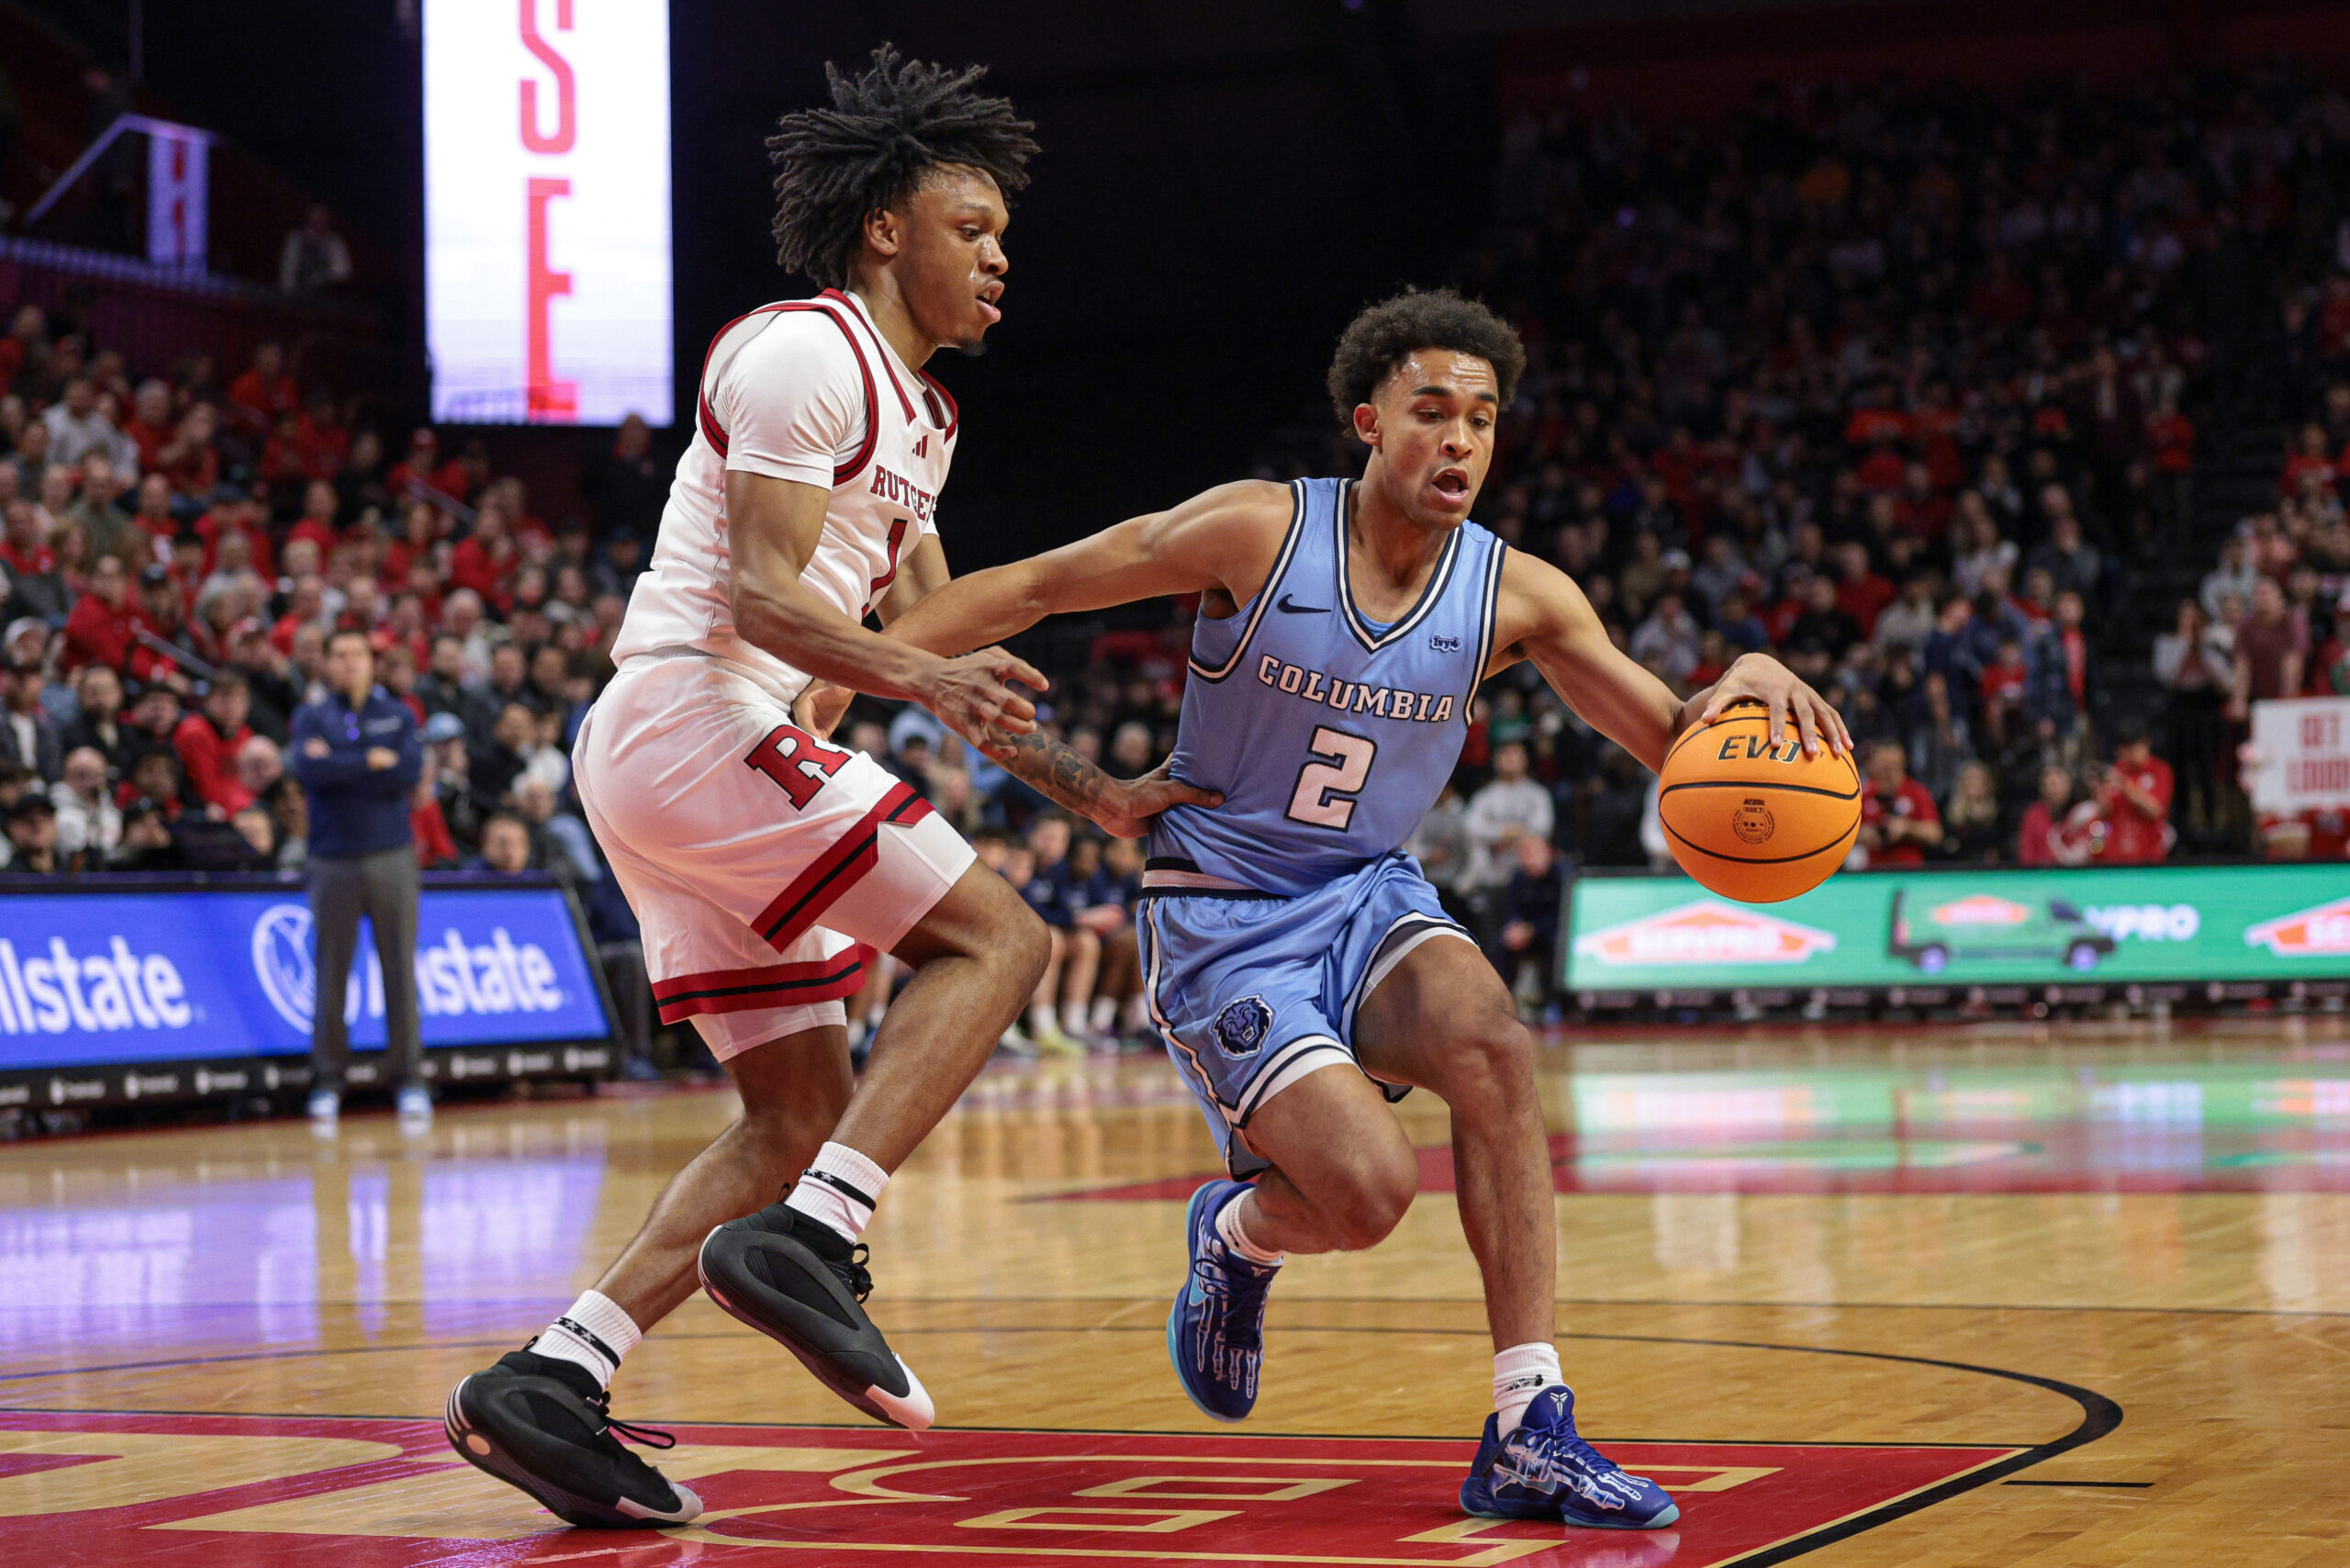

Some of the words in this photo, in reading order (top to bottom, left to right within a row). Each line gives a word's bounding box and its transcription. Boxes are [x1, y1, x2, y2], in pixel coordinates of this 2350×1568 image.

[1258, 654, 1454, 723] COLUMBIA
[744, 723, 852, 811] R
[1284, 724, 1378, 832] 2
[1718, 734, 1802, 764] EVO
